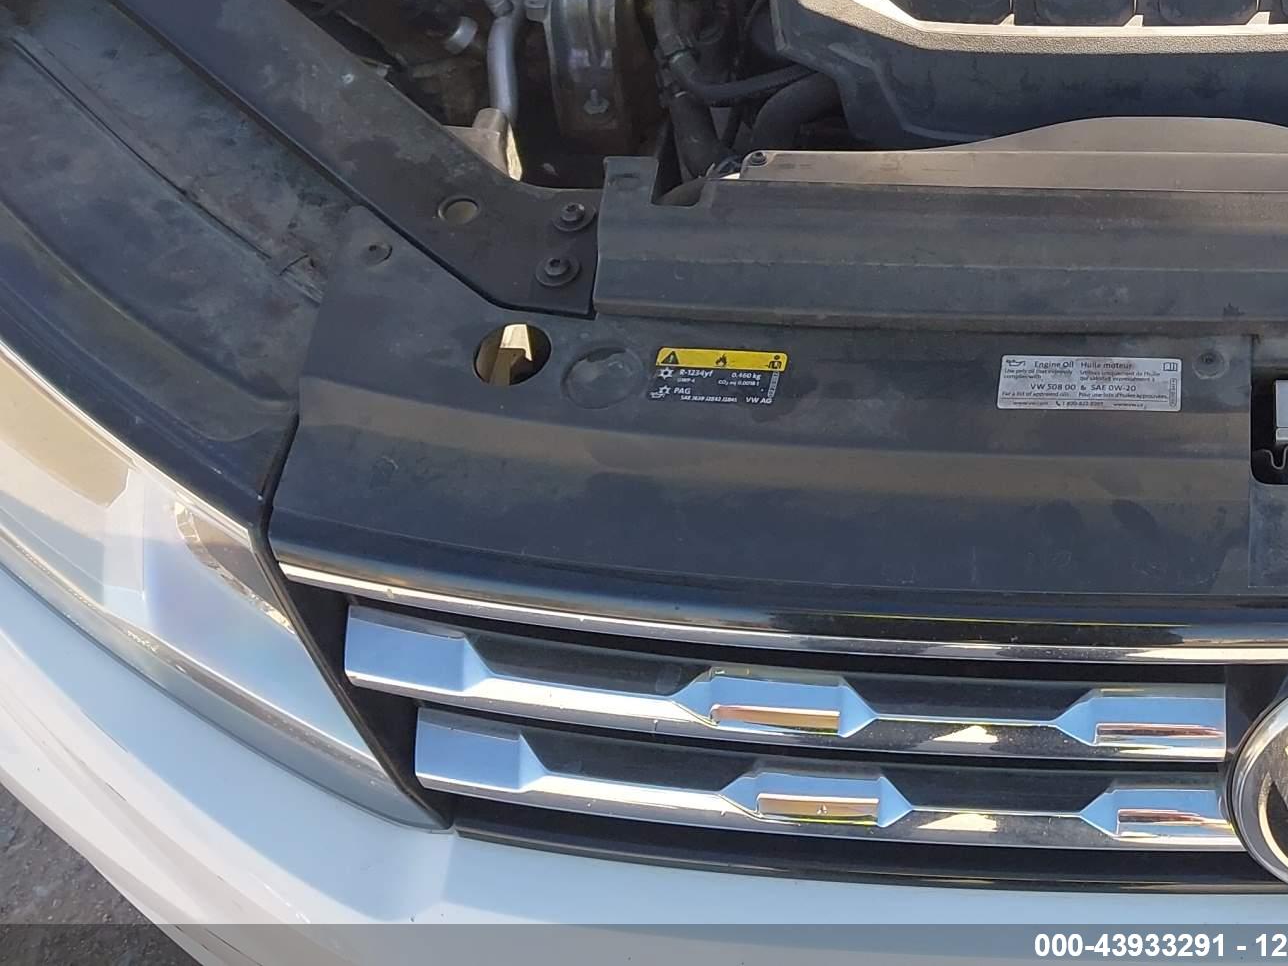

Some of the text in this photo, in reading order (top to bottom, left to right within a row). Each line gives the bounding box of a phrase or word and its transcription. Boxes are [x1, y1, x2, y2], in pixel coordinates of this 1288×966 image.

[1034, 360, 1074, 369] Engine Oil
[1081, 361, 1101, 369] Huile
[680, 369, 713, 379] R-1234yf
[1108, 384, 1137, 392] 0W-20
